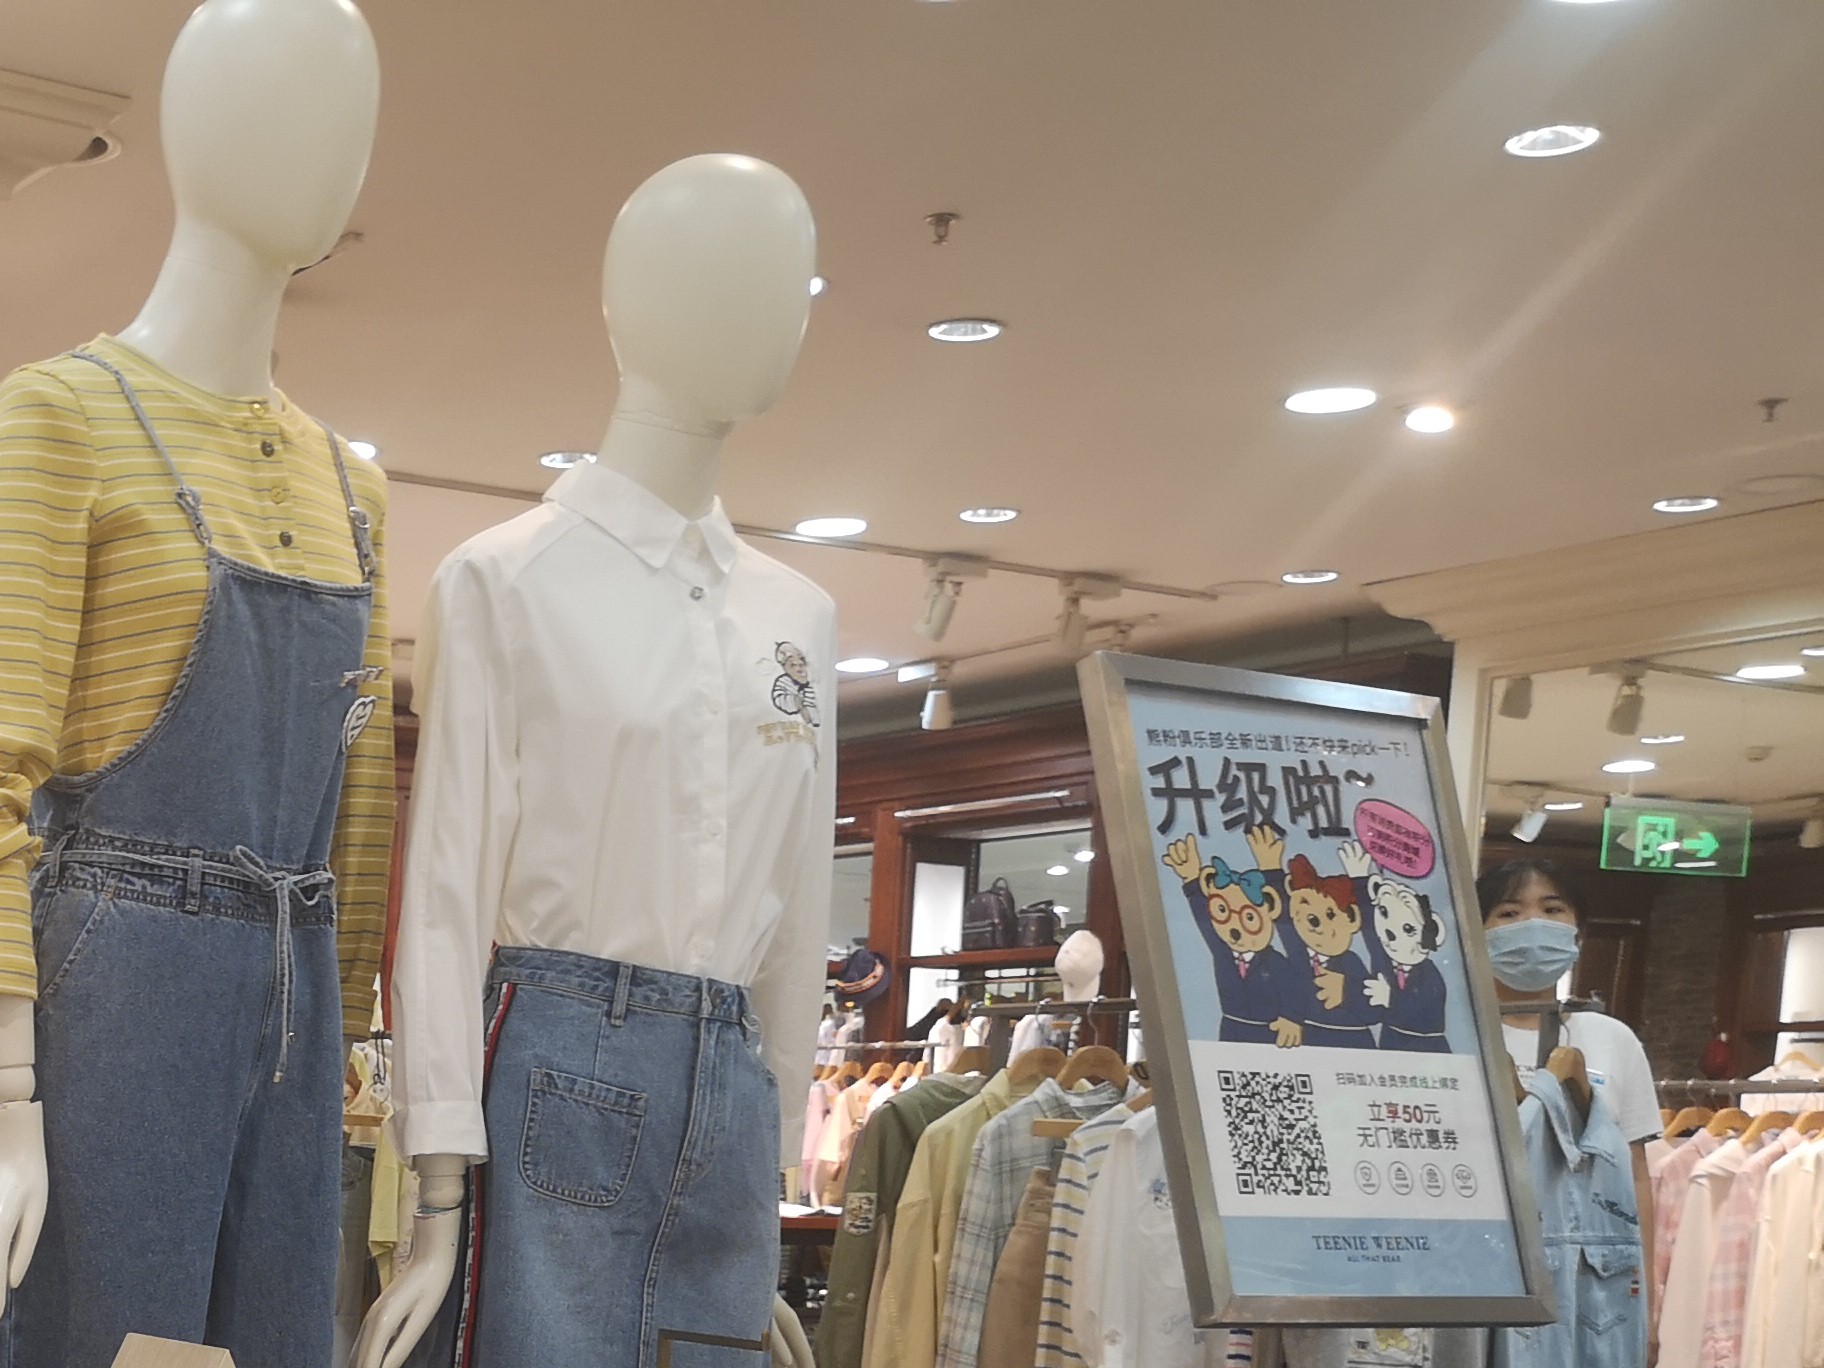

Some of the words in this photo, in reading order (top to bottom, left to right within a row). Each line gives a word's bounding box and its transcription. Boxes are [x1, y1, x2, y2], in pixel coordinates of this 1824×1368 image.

[1367, 1100, 1442, 1125] 立享50元
[1357, 1126, 1459, 1151] 无门槛优惠券
[1312, 1235, 1369, 1251] TEENIE
[1371, 1235, 1431, 1251] WEENIE
